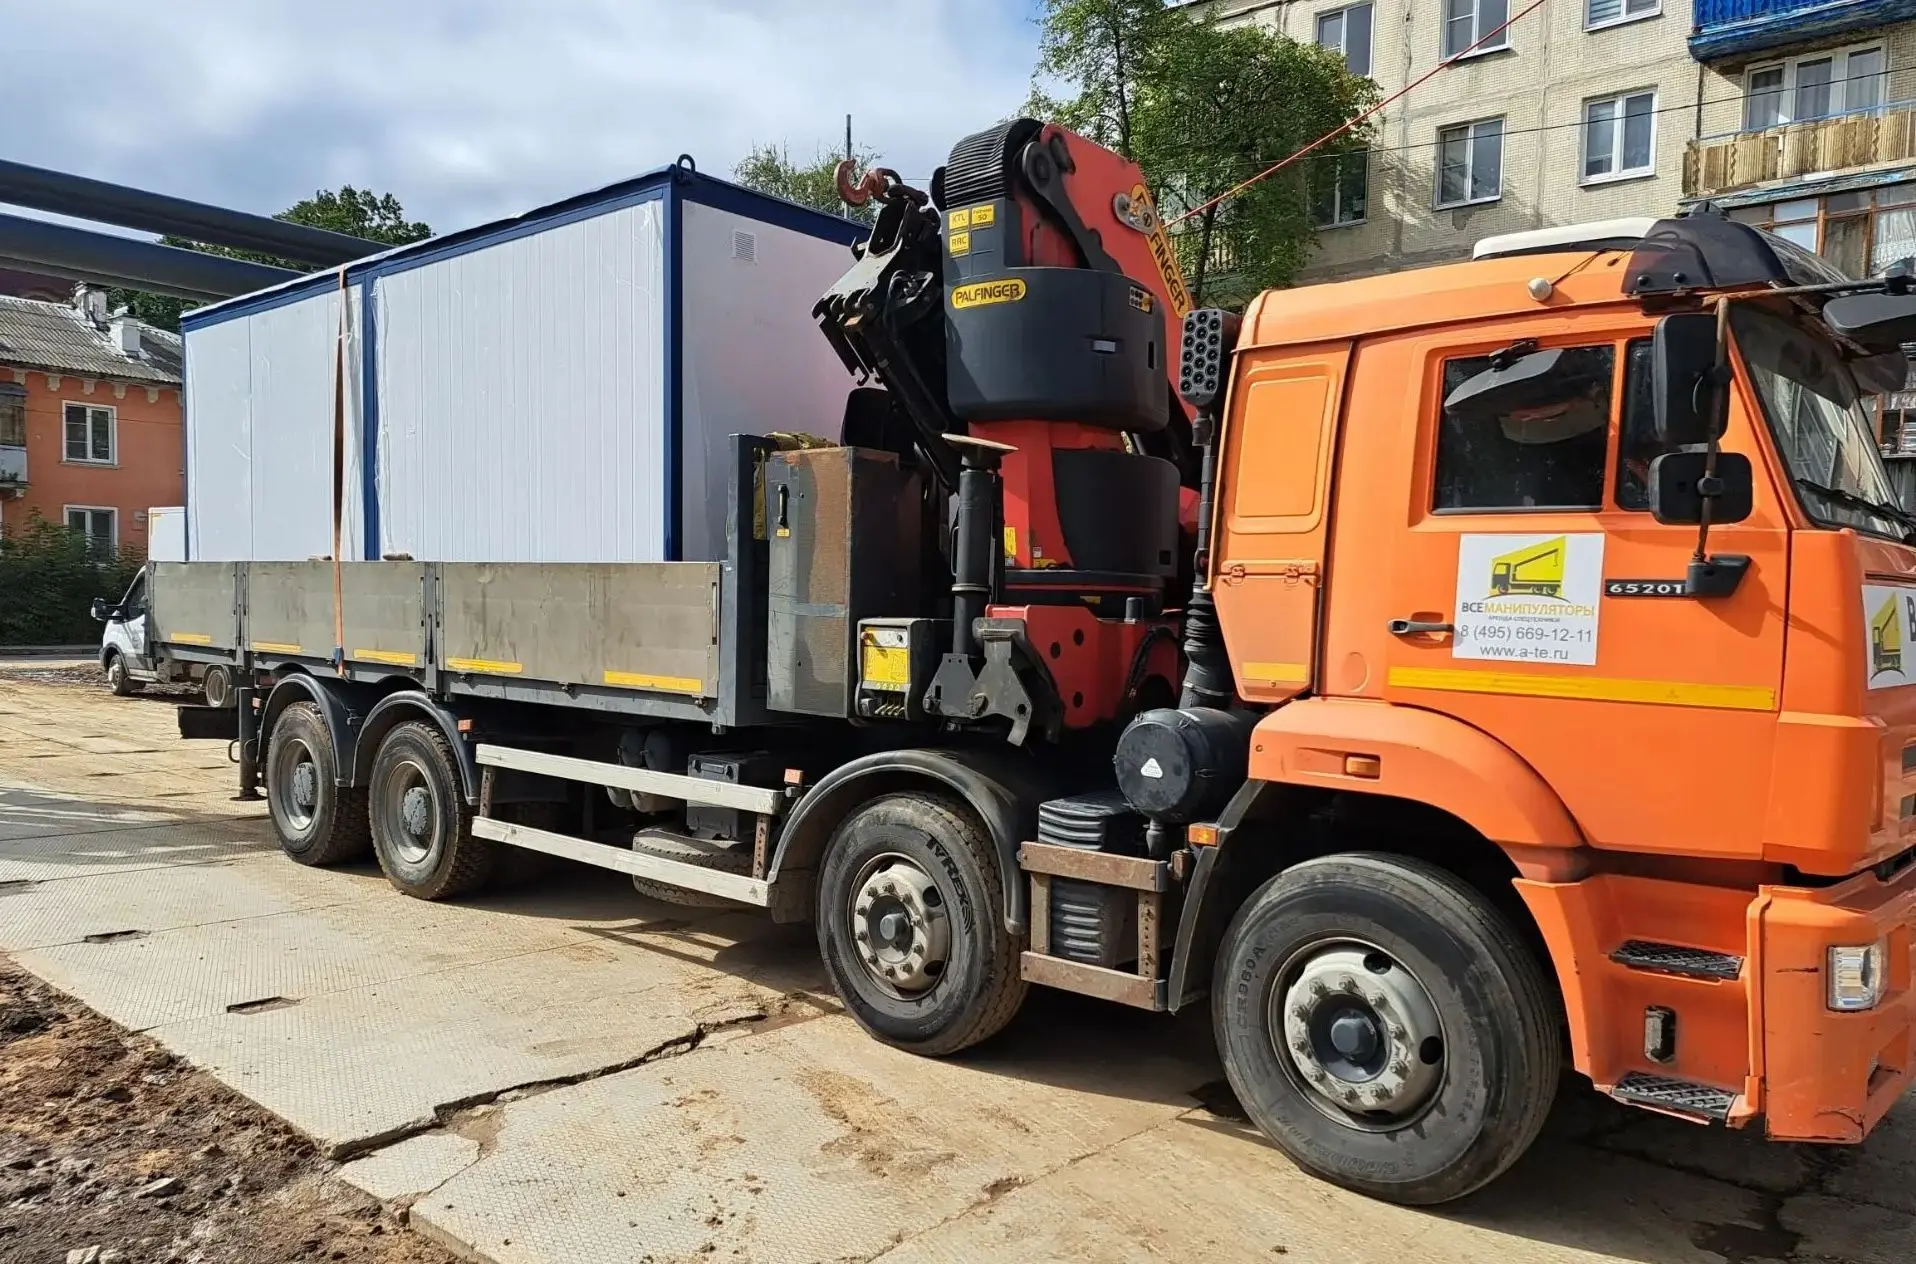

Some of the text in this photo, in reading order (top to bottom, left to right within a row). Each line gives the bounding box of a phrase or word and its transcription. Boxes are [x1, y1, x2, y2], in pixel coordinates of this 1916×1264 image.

[951, 237, 967, 246] RRC
[1134, 192, 1185, 311] PFINGER
[955, 283, 1021, 305] PALFINGER
[1609, 583, 1683, 594] 65201
[1461, 602, 1595, 616] ВСЕМАНИПУЛЯТОРЫ
[1460, 625, 1592, 643] 8 (495) 669-12-11
[1480, 645, 1569, 660] www.a-te.ru
